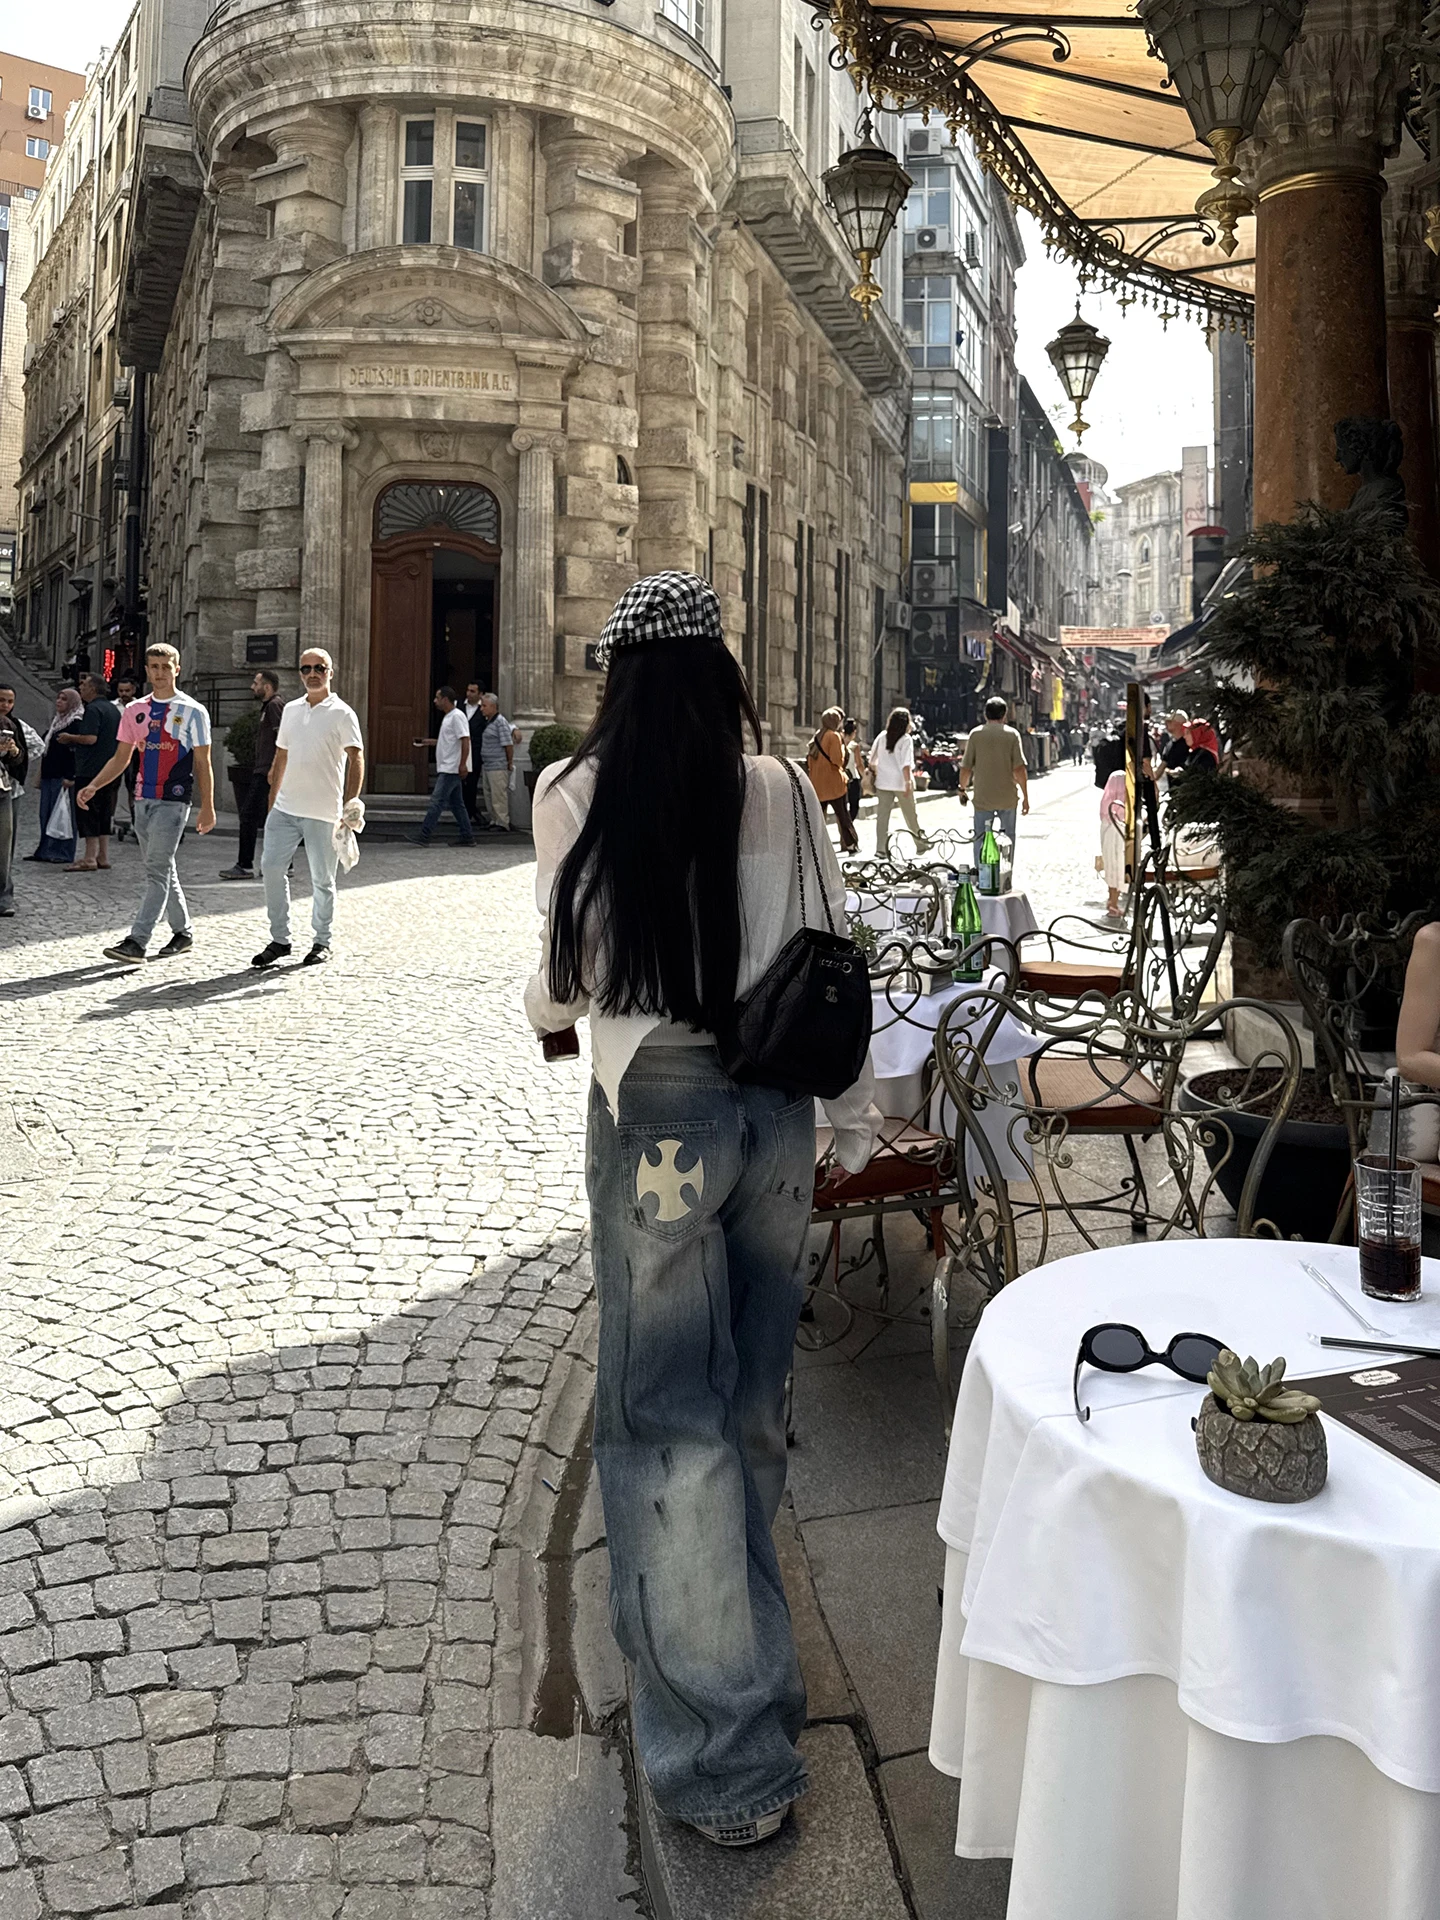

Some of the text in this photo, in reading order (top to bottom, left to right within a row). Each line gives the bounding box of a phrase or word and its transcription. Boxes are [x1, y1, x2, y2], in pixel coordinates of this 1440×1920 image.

[349, 367, 513, 392] DEUTSCHE ORIENTBANK A.G.
[146, 741, 176, 752] Spotify
